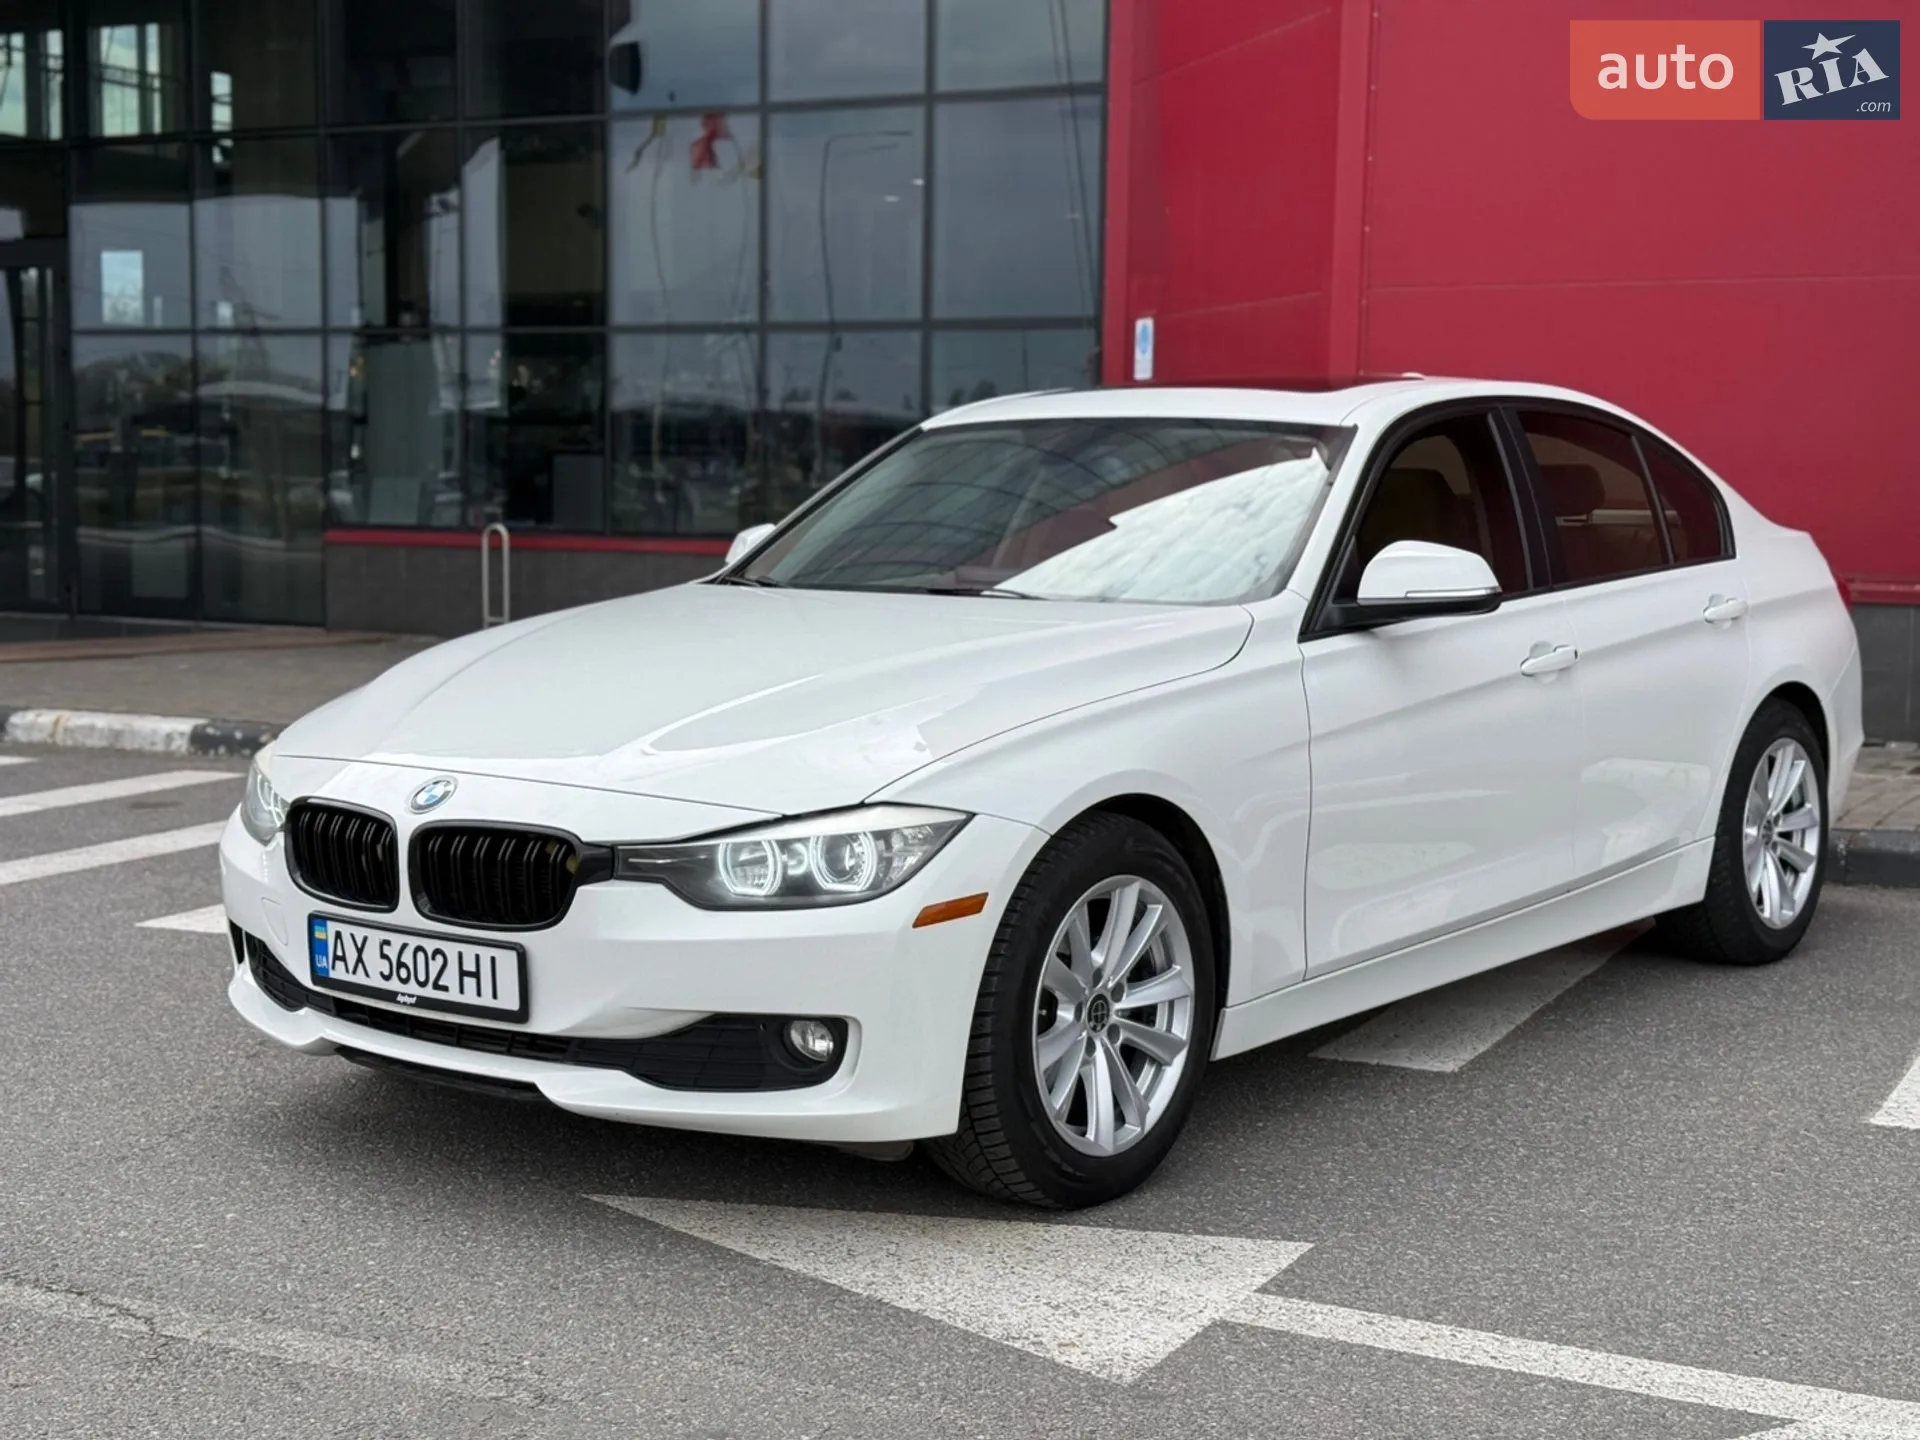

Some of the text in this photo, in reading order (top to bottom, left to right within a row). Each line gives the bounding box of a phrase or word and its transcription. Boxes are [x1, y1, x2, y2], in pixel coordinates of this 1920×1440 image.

[315, 954, 328, 968] UA
[331, 930, 498, 1000] AX 5602 HI
